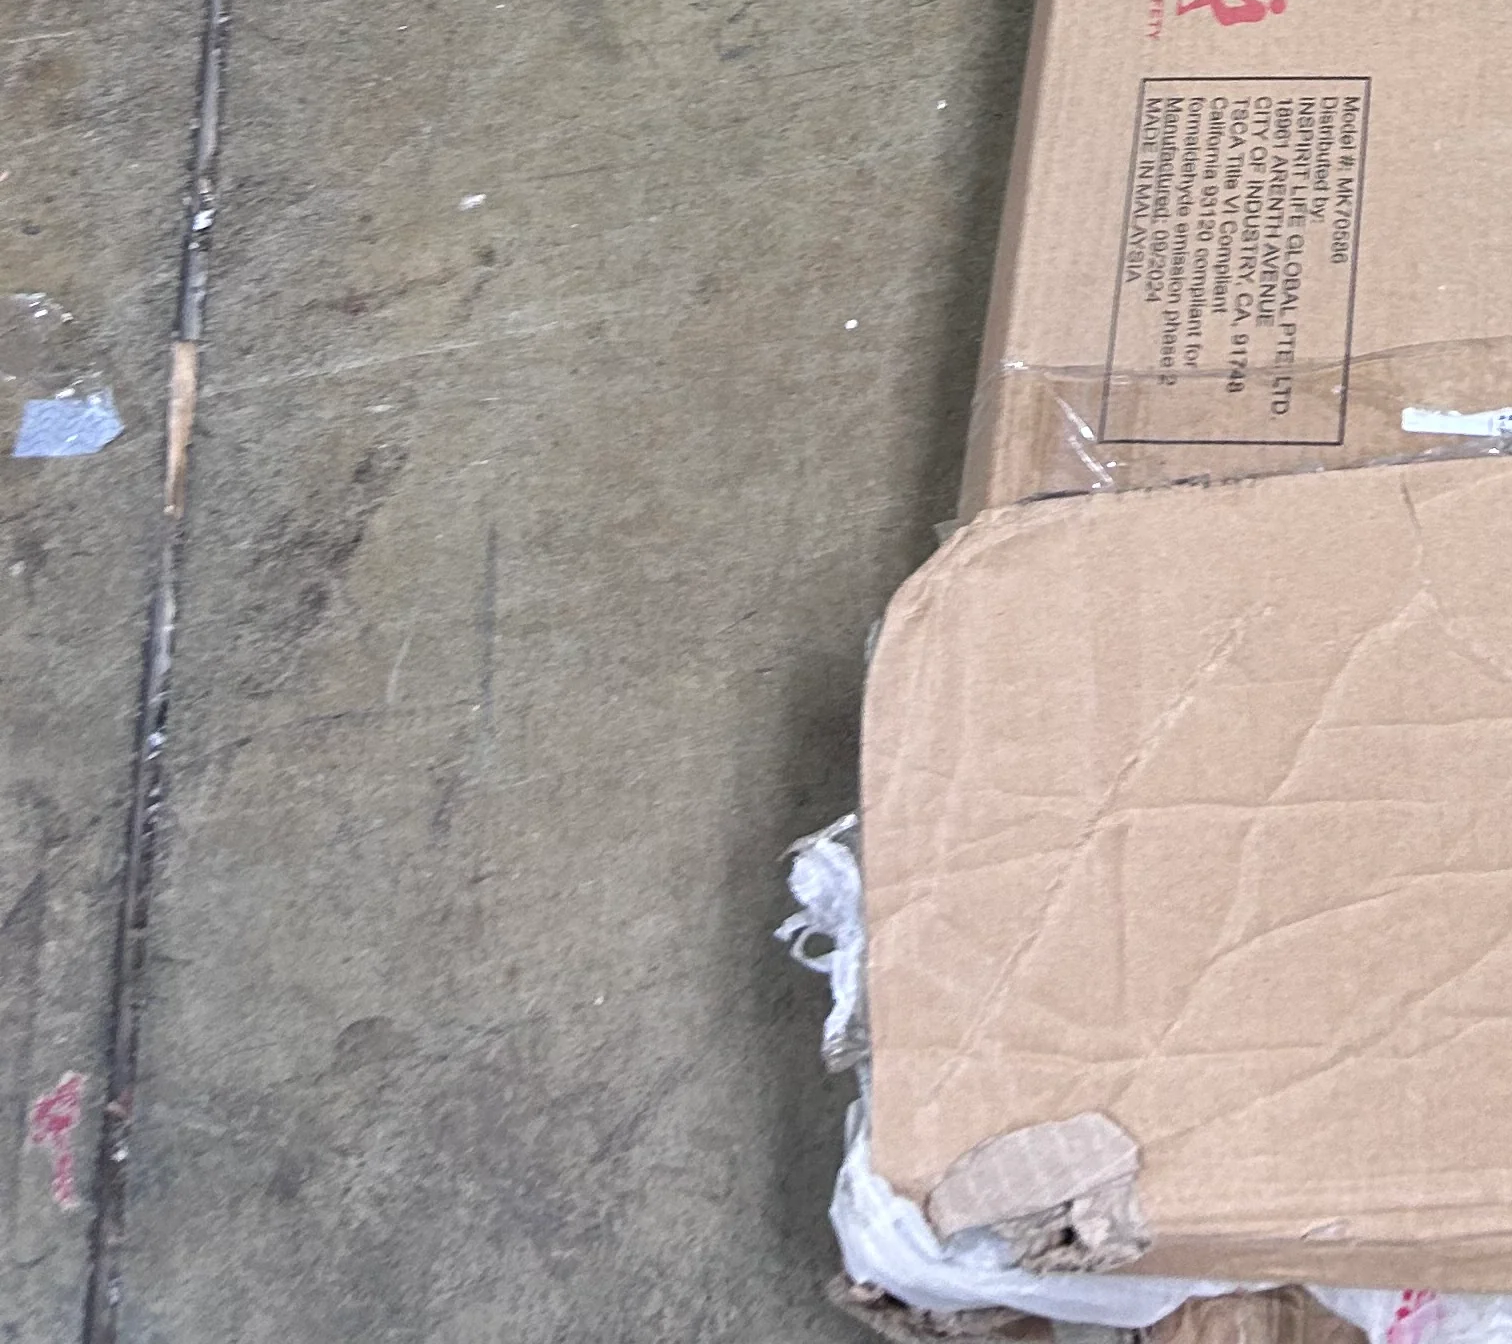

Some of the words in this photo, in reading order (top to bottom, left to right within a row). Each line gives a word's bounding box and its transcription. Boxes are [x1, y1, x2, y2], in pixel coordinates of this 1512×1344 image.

[1140, 97, 1164, 152] MADE
[1175, 97, 1207, 216] formaldehyde
[1202, 97, 1229, 179] California
[1228, 96, 1251, 148] TSCA
[1250, 96, 1273, 140] CITY
[1292, 97, 1317, 180] INSPIRIT
[1313, 97, 1339, 190] Distributed
[1340, 96, 1361, 149] Model
[1137, 160, 1156, 178] IN
[1223, 152, 1246, 189] Title
[1247, 146, 1269, 174] OF
[1264, 155, 1290, 237] ARENTH
[1125, 184, 1154, 282] MALAYSIA
[1196, 185, 1220, 241] 93120
[1221, 195, 1242, 213] VI
[1236, 180, 1265, 285] INDUSTRY,
[1287, 186, 1310, 227] LIFE
[1330, 177, 1355, 263] MK70586
[1165, 222, 1193, 303] emission
[1185, 248, 1214, 337] compliant
[1211, 221, 1239, 313] Compliant
[1256, 242, 1282, 327] AVENUE
[1279, 234, 1306, 317] GLOBAL
[1158, 310, 1184, 367] phase
[1182, 344, 1204, 368] for
